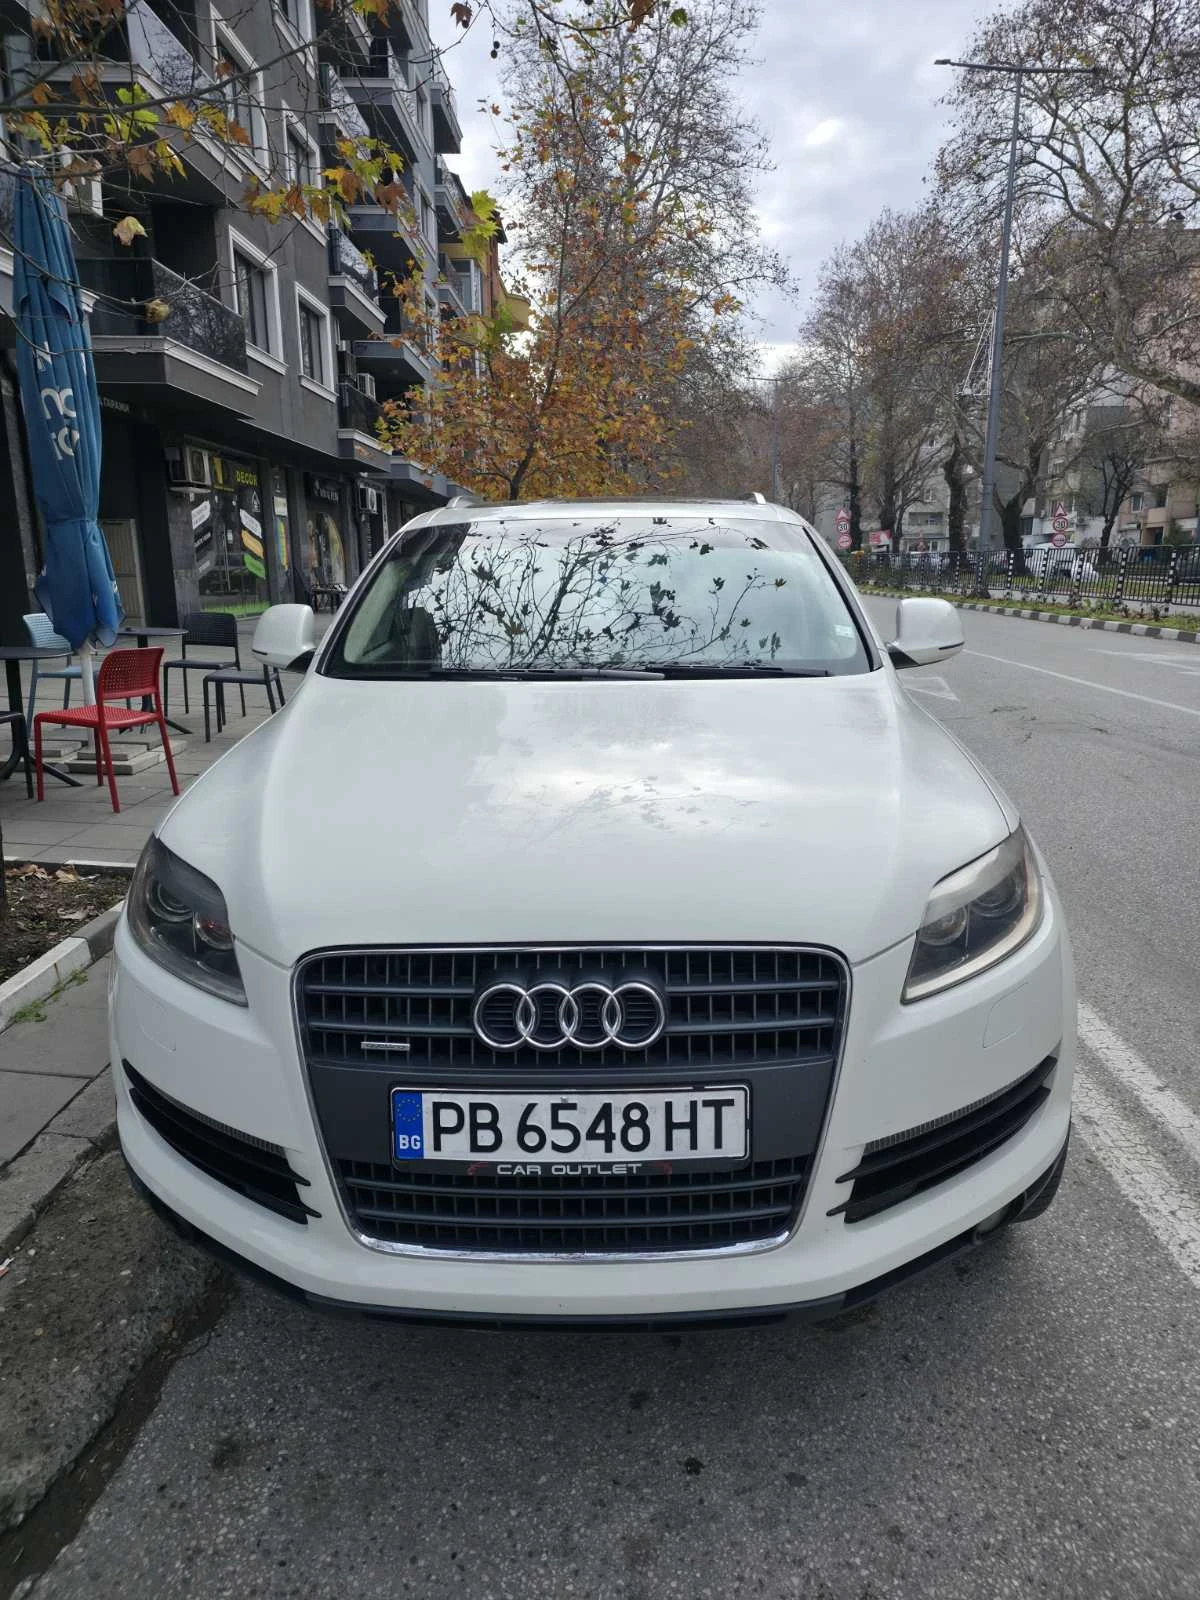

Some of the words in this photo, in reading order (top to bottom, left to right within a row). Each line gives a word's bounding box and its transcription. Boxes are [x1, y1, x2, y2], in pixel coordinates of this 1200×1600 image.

[839, 523, 848, 532] 30
[1056, 521, 1065, 529] 30
[432, 1101, 503, 1153] PB
[517, 1101, 650, 1154] 6548
[665, 1098, 735, 1152] HT
[399, 1135, 421, 1150] BG
[497, 1163, 541, 1176] CAR
[552, 1163, 642, 1176] OUTLET
